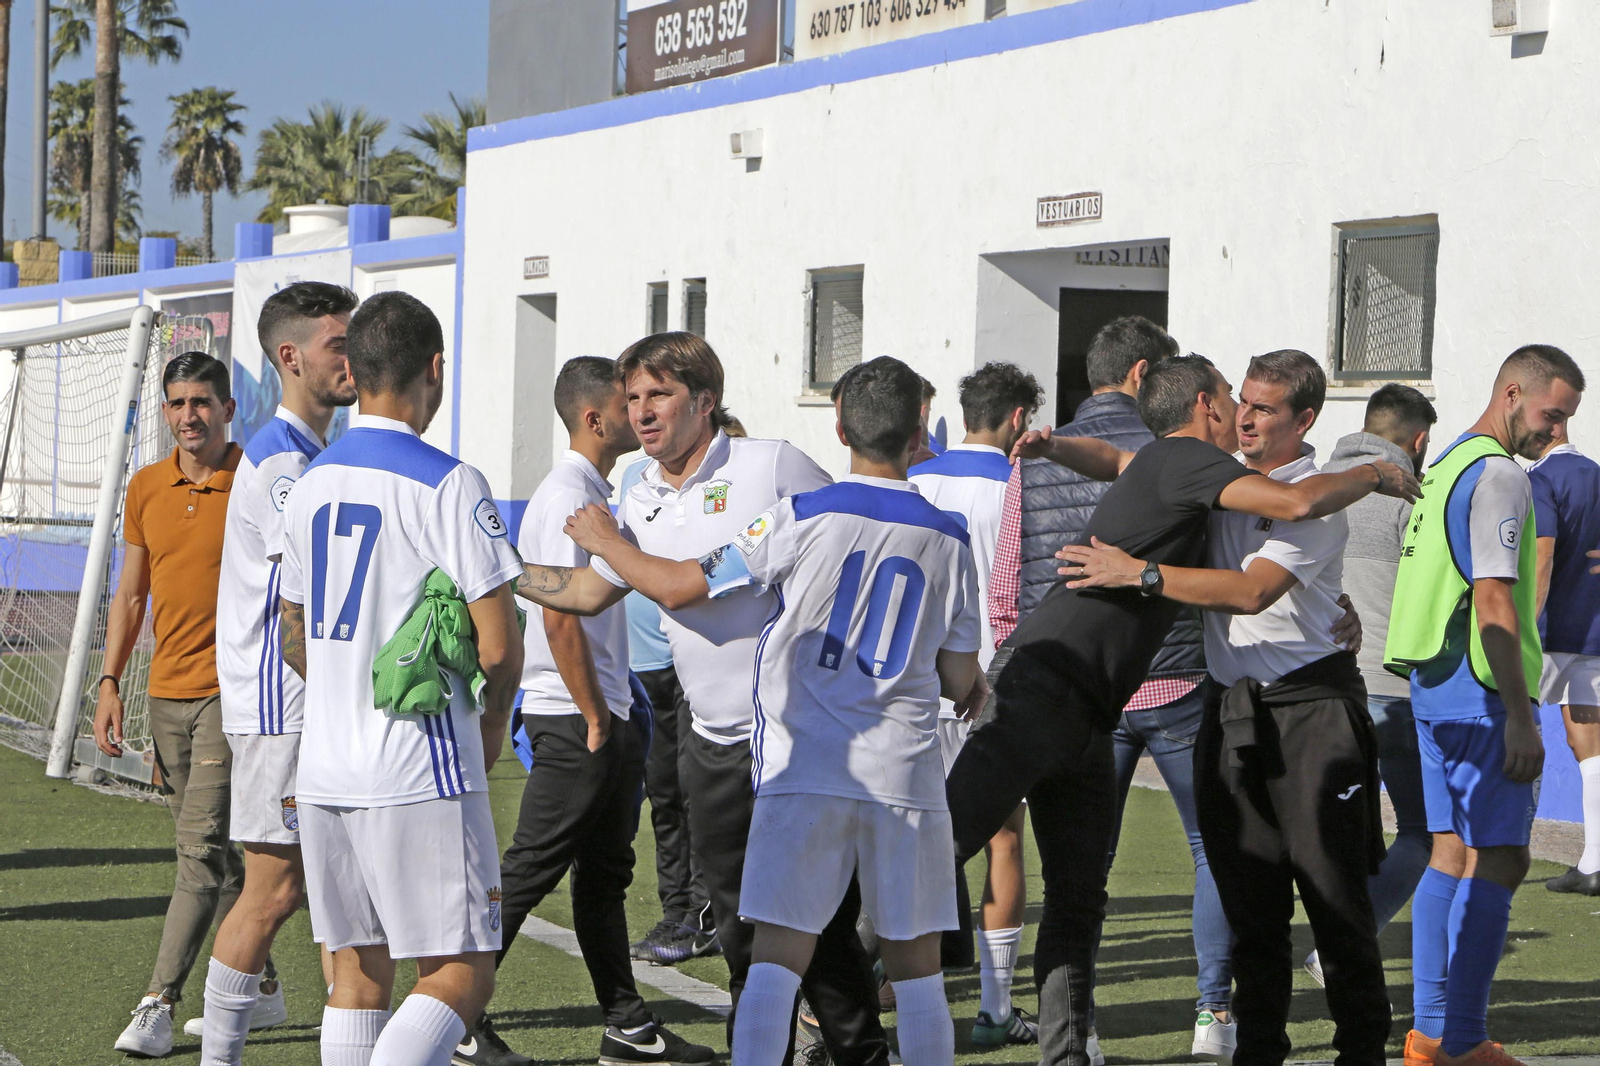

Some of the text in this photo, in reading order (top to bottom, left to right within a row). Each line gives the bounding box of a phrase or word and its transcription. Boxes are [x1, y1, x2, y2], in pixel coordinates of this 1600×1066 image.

[654, 0, 748, 56] 658 563 592
[810, 10, 831, 40] 630
[833, 3, 856, 33] 787
[860, 0, 881, 29] 103
[654, 48, 746, 82] marisoldiego@gmail.com
[1040, 198, 1099, 219] VESTUARIOS
[311, 501, 383, 642] 17
[818, 549, 926, 680] 10
